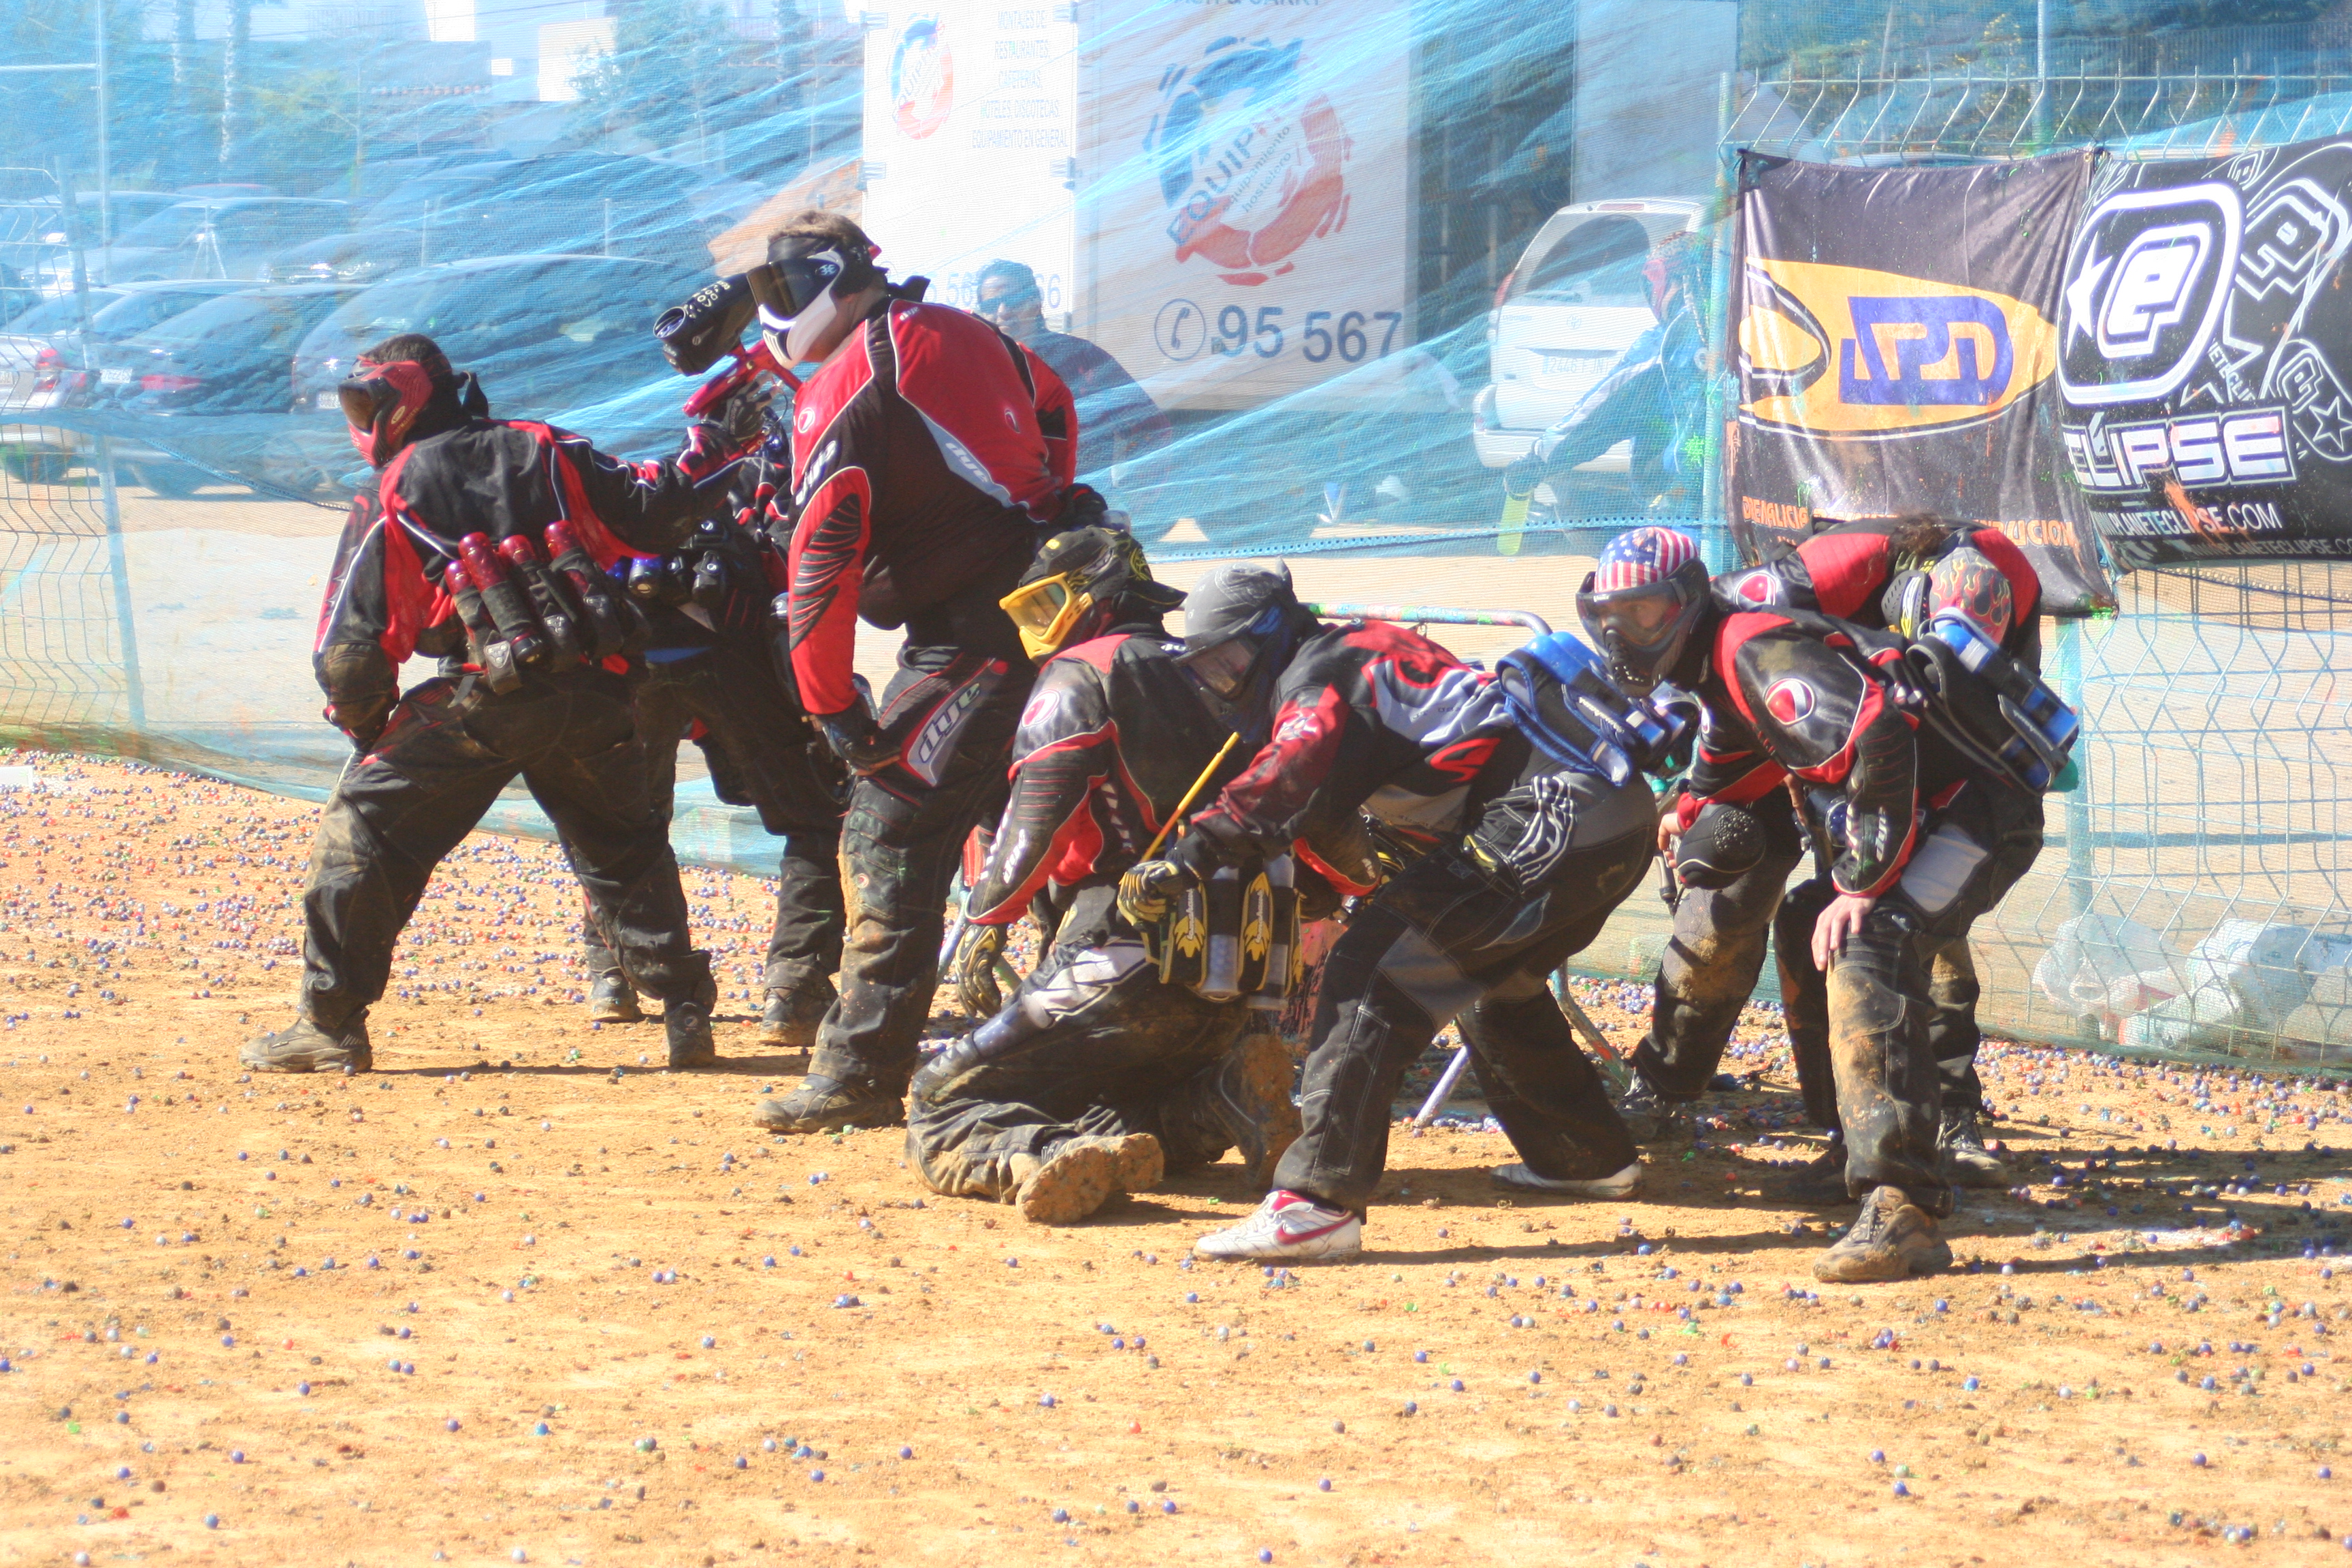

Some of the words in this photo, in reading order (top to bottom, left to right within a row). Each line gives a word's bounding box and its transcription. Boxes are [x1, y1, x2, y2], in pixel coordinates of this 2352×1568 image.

[1218, 305, 1284, 359] 95
[1303, 310, 1402, 363] 567
[919, 682, 981, 763] dye
